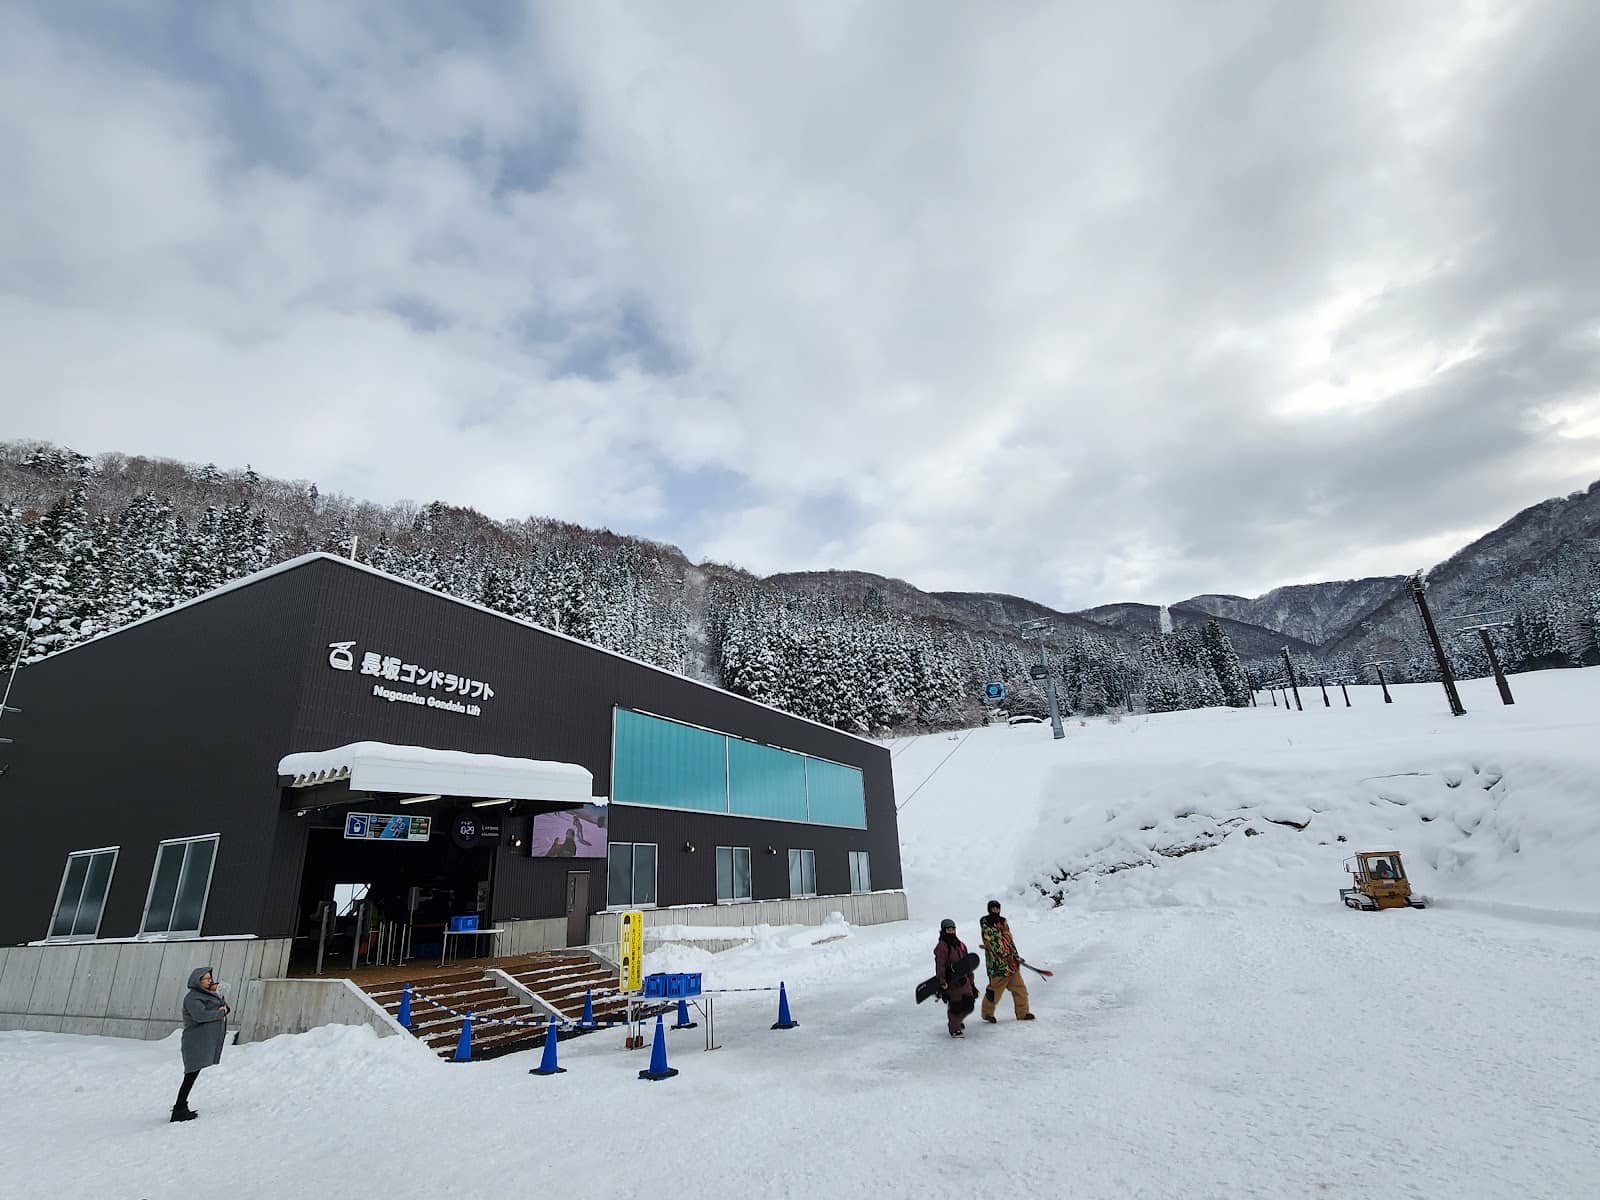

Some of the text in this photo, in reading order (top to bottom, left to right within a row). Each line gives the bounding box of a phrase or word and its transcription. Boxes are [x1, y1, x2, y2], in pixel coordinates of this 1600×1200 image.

[361, 652, 495, 700] 長坂ゴンドラリフト
[373, 685, 481, 716] Nagasaka Gondola Lift
